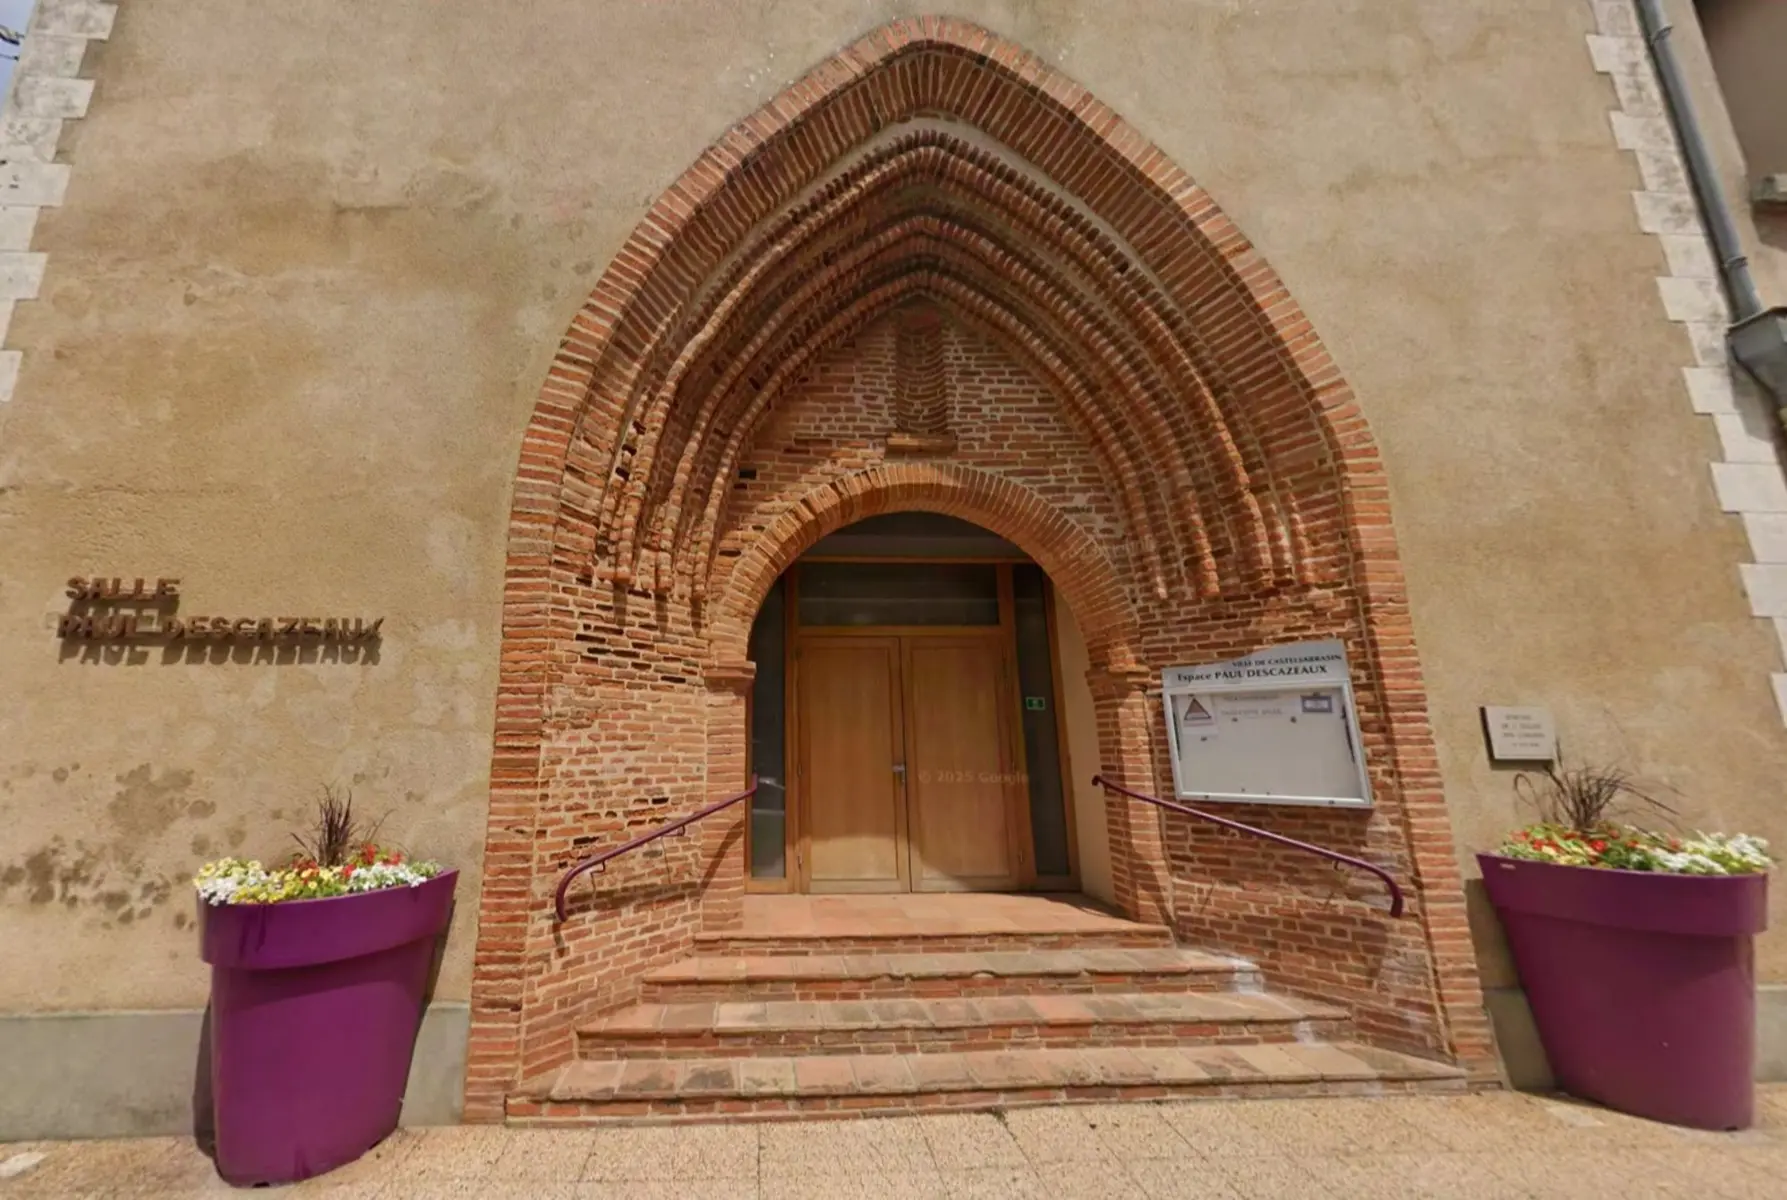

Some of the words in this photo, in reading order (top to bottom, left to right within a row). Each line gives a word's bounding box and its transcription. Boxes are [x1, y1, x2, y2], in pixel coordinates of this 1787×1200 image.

[65, 576, 181, 600] SALLE
[56, 613, 152, 639] PAUL
[163, 615, 384, 641] DESCAZEAUX
[1177, 672, 1212, 684] Espace
[1214, 669, 1243, 680] PAUL
[1246, 664, 1328, 678] DESCAZEAUX
